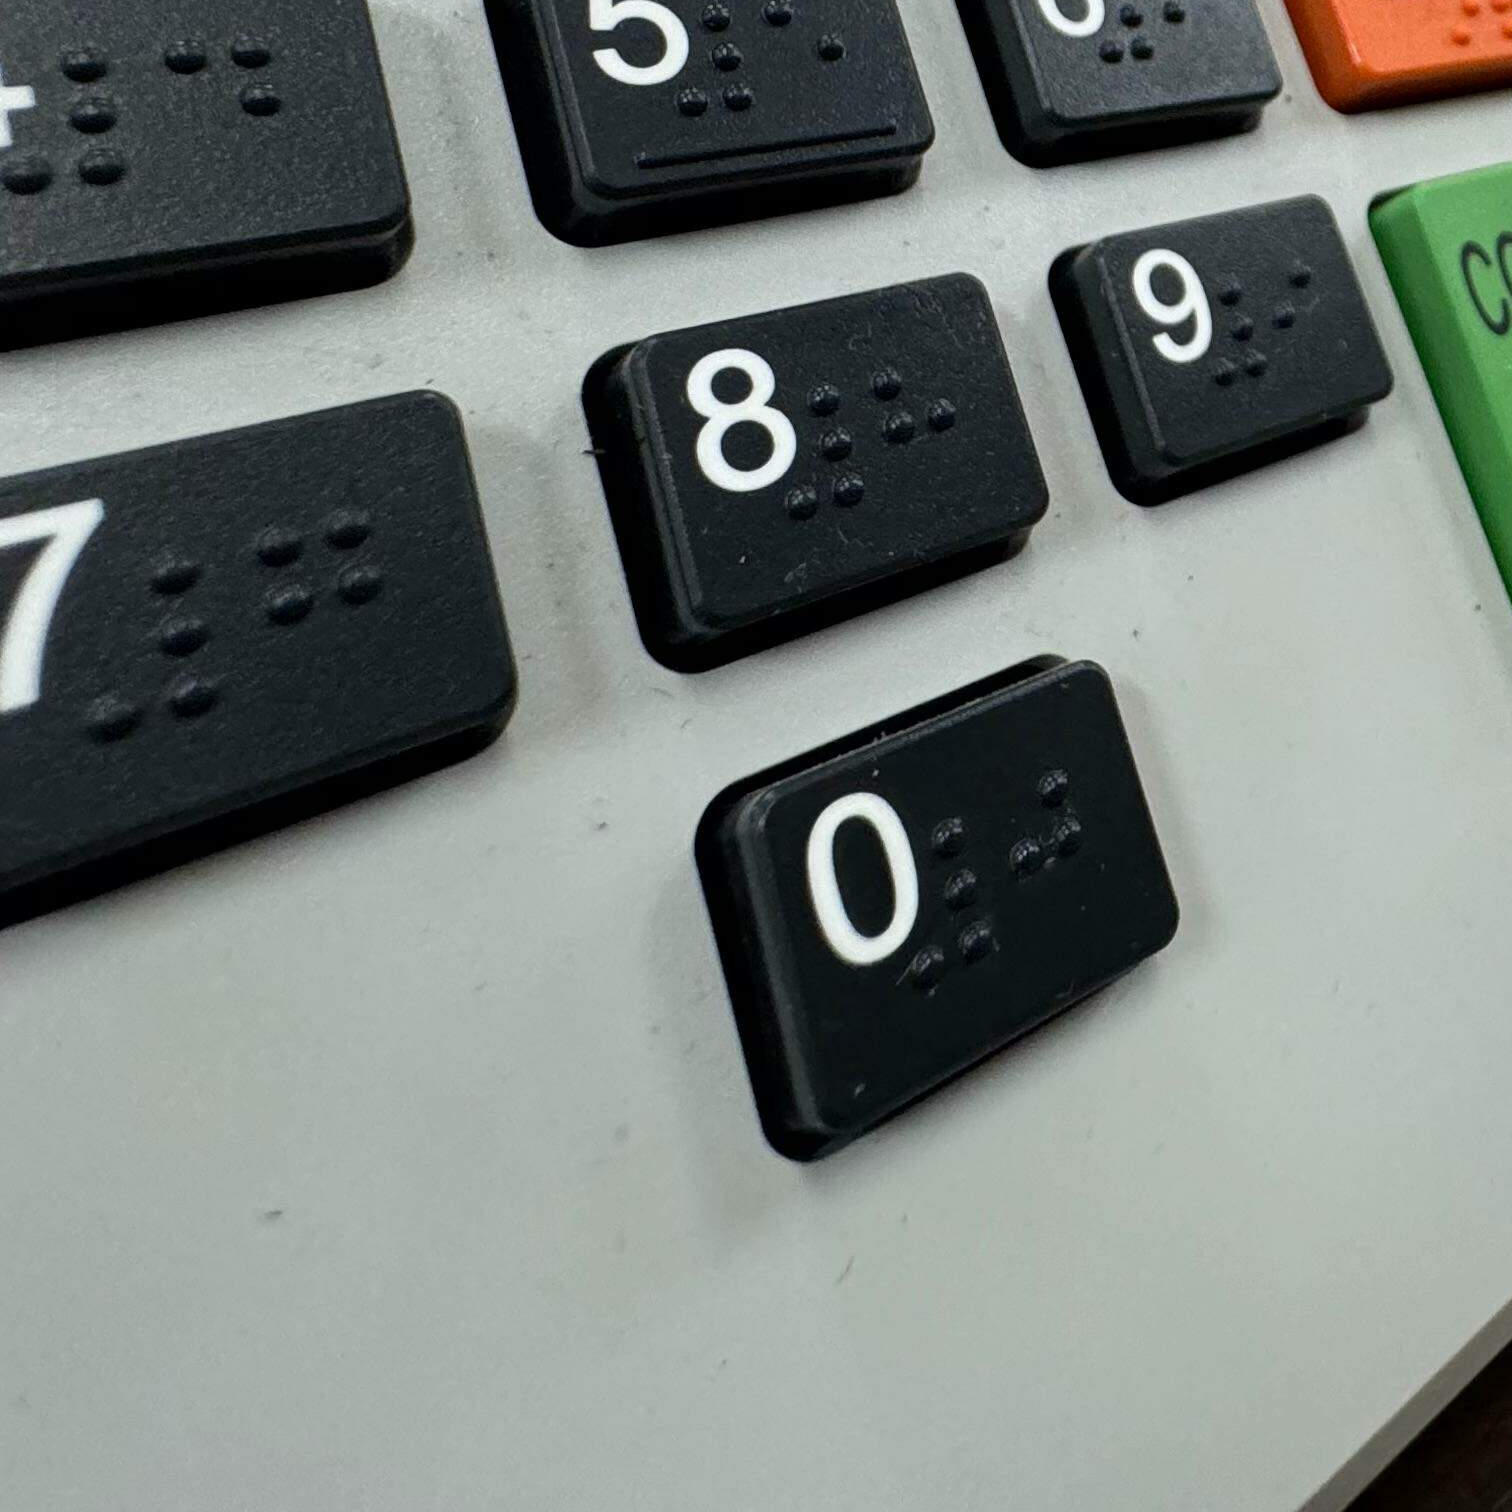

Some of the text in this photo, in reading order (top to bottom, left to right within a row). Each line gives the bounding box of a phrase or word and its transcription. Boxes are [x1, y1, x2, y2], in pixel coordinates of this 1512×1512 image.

[1131, 248, 1213, 364] 9
[686, 348, 797, 492] 8
[0, 498, 105, 714] 7
[807, 792, 919, 966] 0
